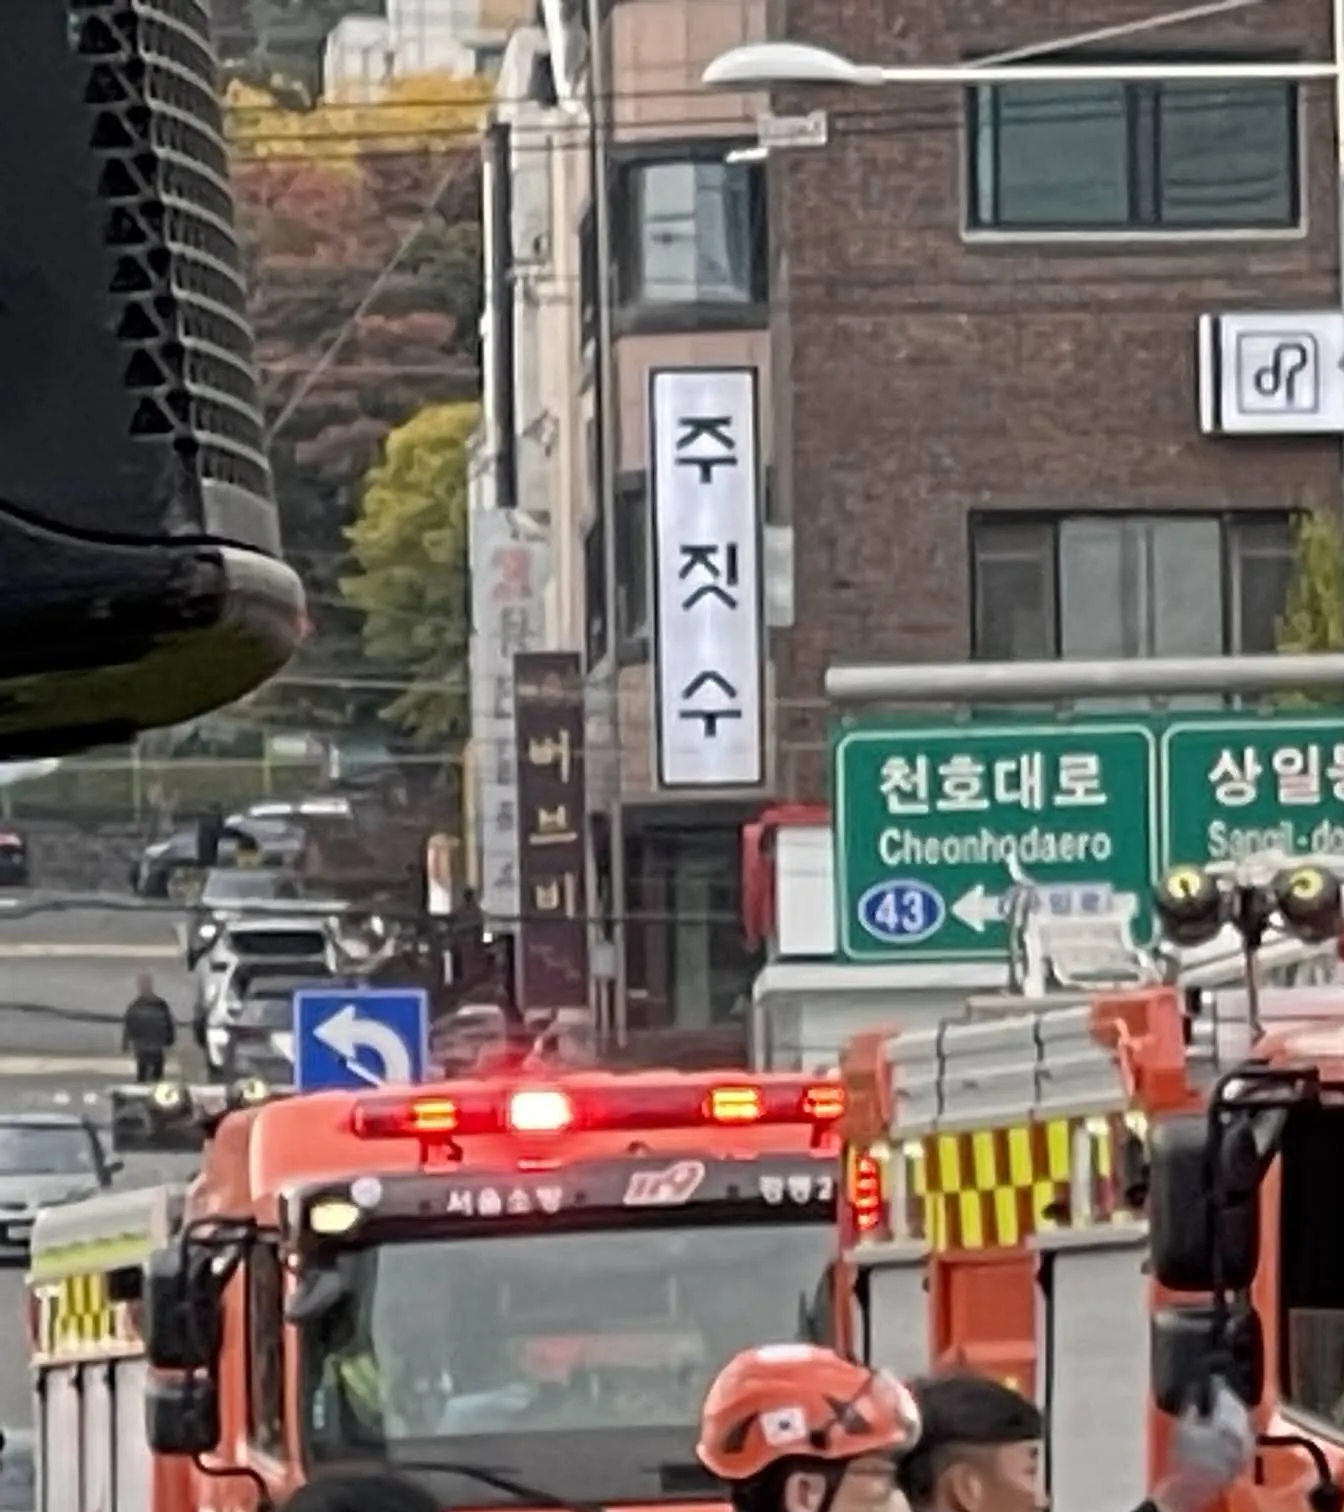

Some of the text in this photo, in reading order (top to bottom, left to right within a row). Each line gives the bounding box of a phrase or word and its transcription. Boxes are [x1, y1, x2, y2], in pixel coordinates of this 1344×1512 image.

[675, 415, 743, 739] 주짓수
[879, 751, 1108, 814] 천호대로
[878, 825, 1112, 865] Cheonhodaero
[874, 890, 925, 933] 43
